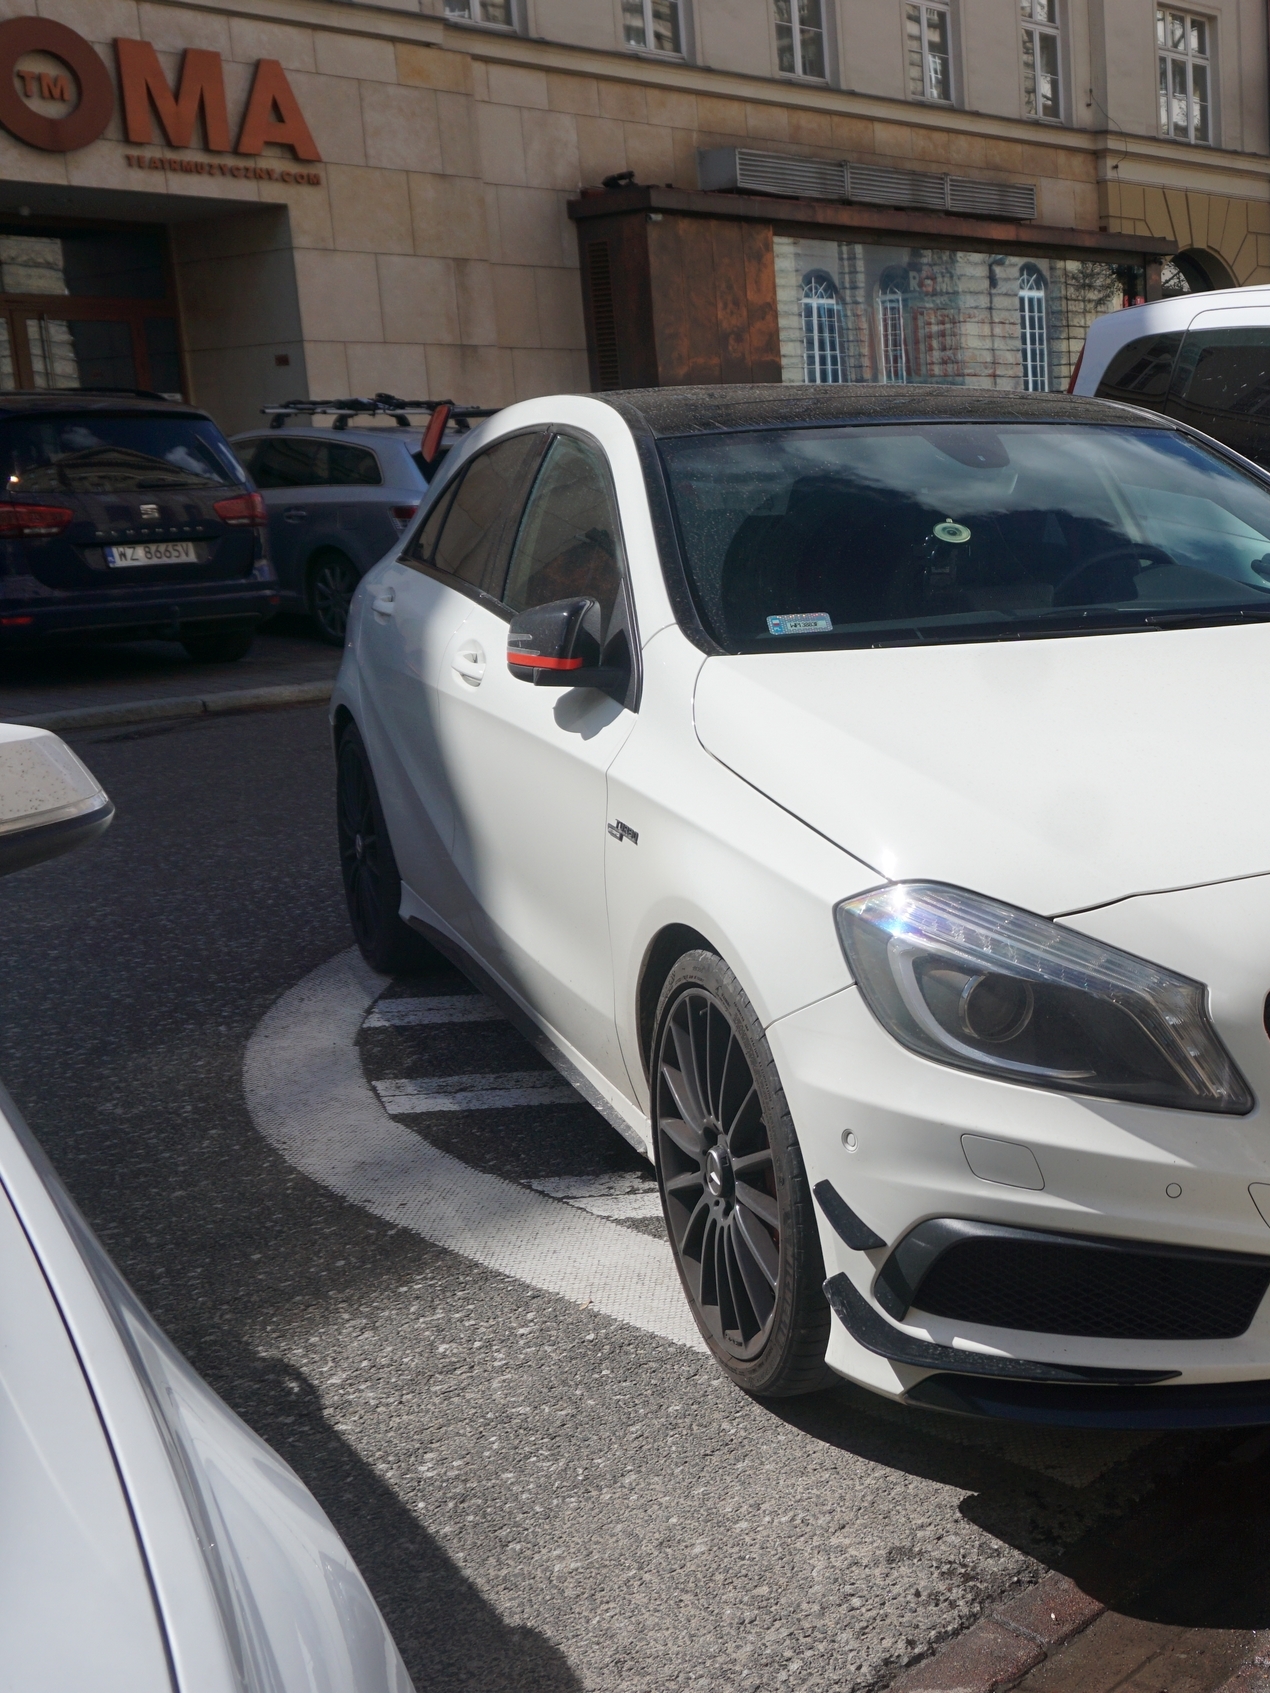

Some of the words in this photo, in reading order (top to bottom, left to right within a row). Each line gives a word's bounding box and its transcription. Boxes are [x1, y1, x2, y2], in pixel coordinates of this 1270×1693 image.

[17, 69, 71, 101] TM
[125, 154, 322, 186] TEATRMUZYCZNY.COM
[117, 545, 139, 562] WZ
[144, 543, 189, 560] 8665V
